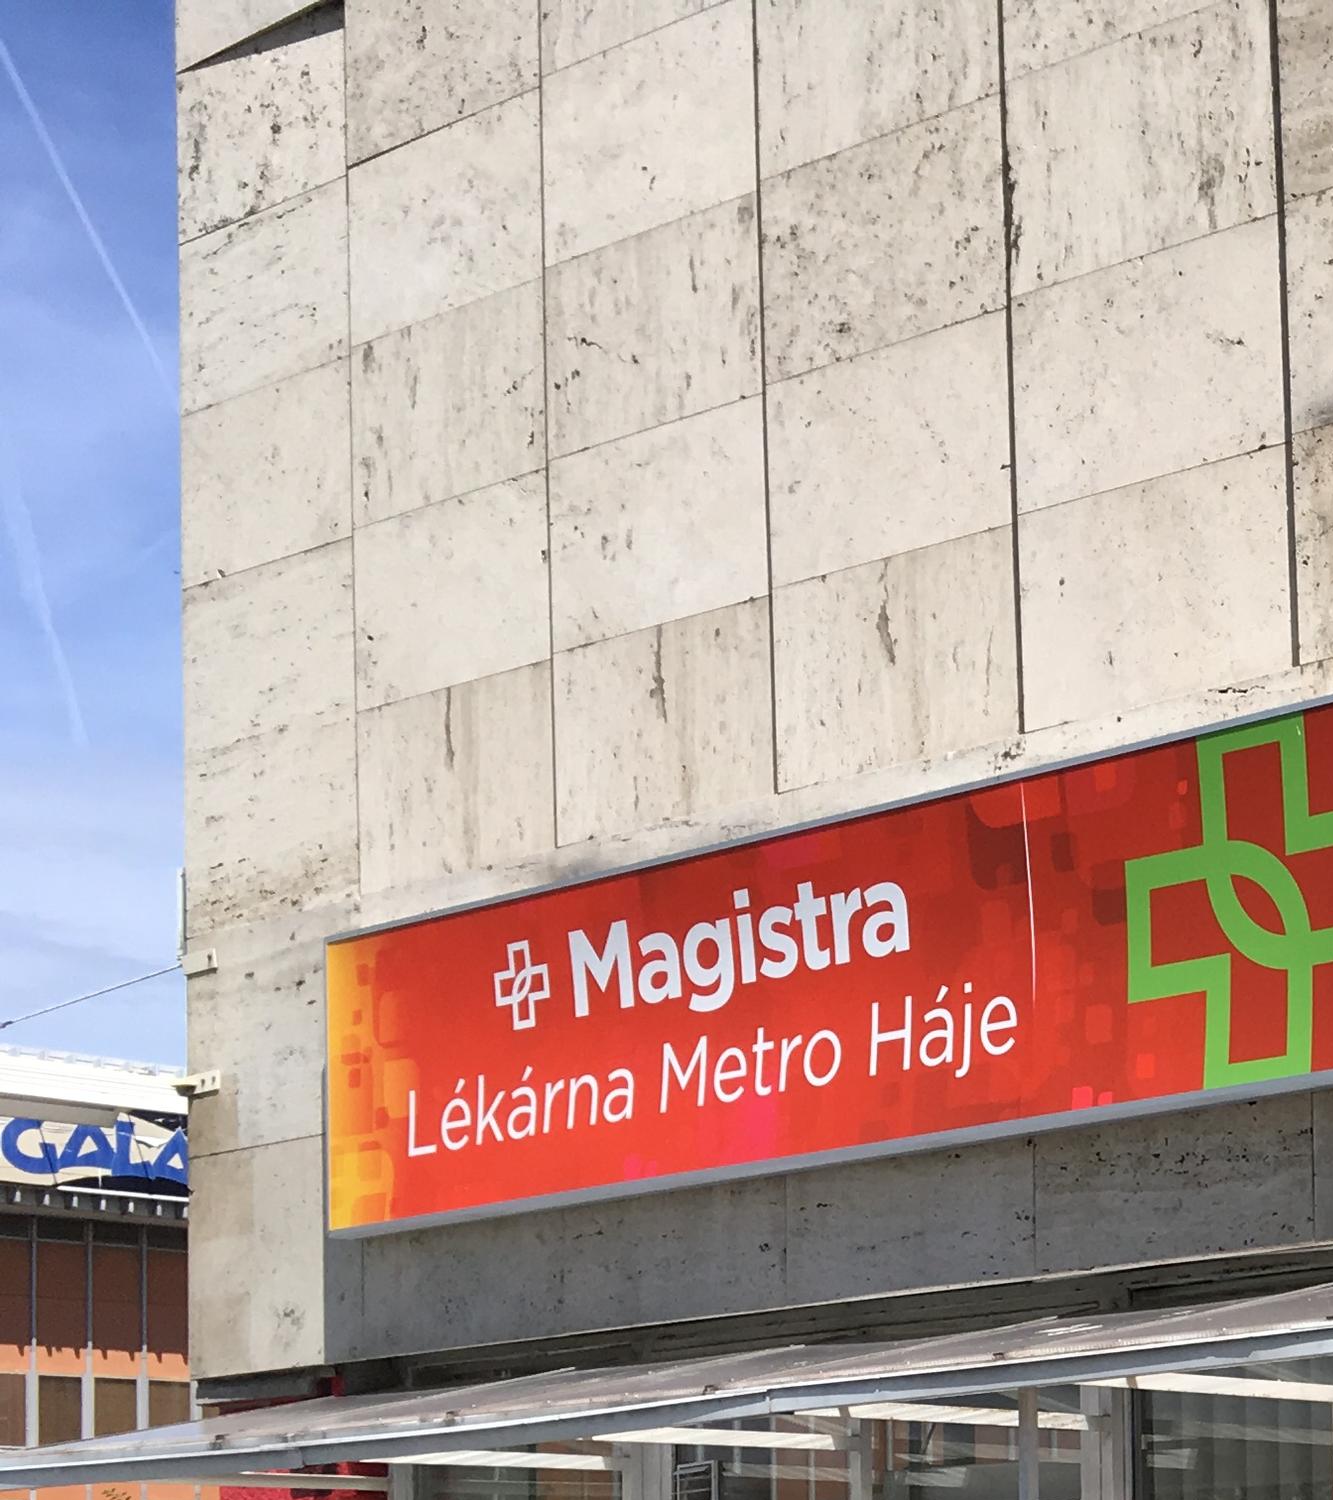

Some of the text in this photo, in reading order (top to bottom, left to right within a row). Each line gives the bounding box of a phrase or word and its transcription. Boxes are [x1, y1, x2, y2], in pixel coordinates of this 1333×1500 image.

[569, 881, 910, 1018] Magistra
[406, 982, 1018, 1157] Lékárna Metro Háje
